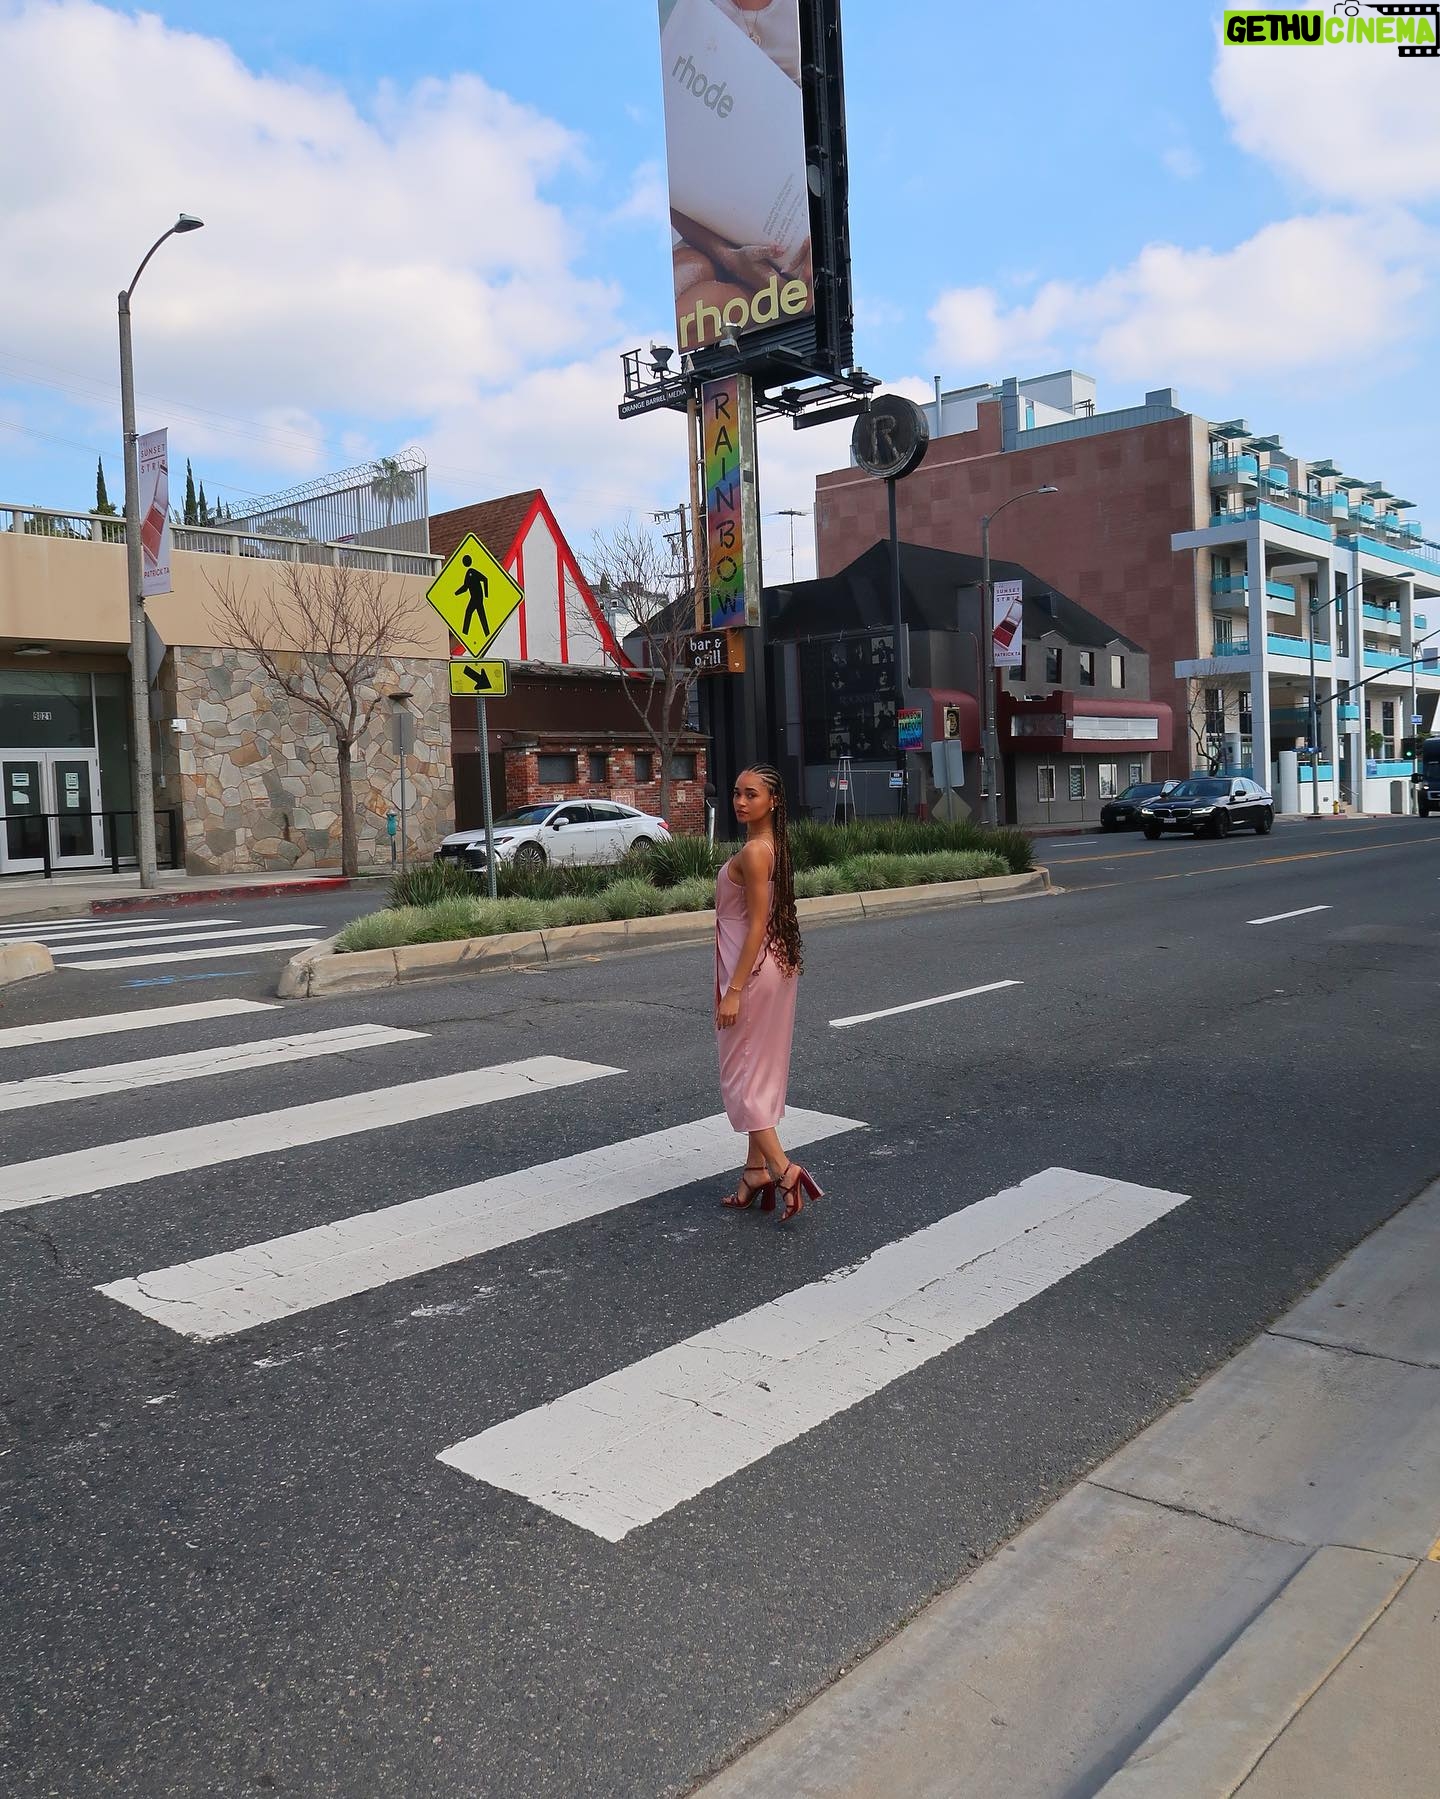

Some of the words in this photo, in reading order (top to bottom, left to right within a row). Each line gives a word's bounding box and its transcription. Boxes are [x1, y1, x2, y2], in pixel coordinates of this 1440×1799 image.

[672, 54, 734, 118] rhode
[680, 274, 808, 349] rhode
[621, 400, 645, 414] ORANGE
[645, 394, 667, 407] BARREL
[667, 388, 687, 399] MEDIA
[140, 443, 165, 458] SUNSET
[711, 392, 739, 616] RAINBOW
[689, 637, 712, 652] bar
[714, 638, 722, 649] &
